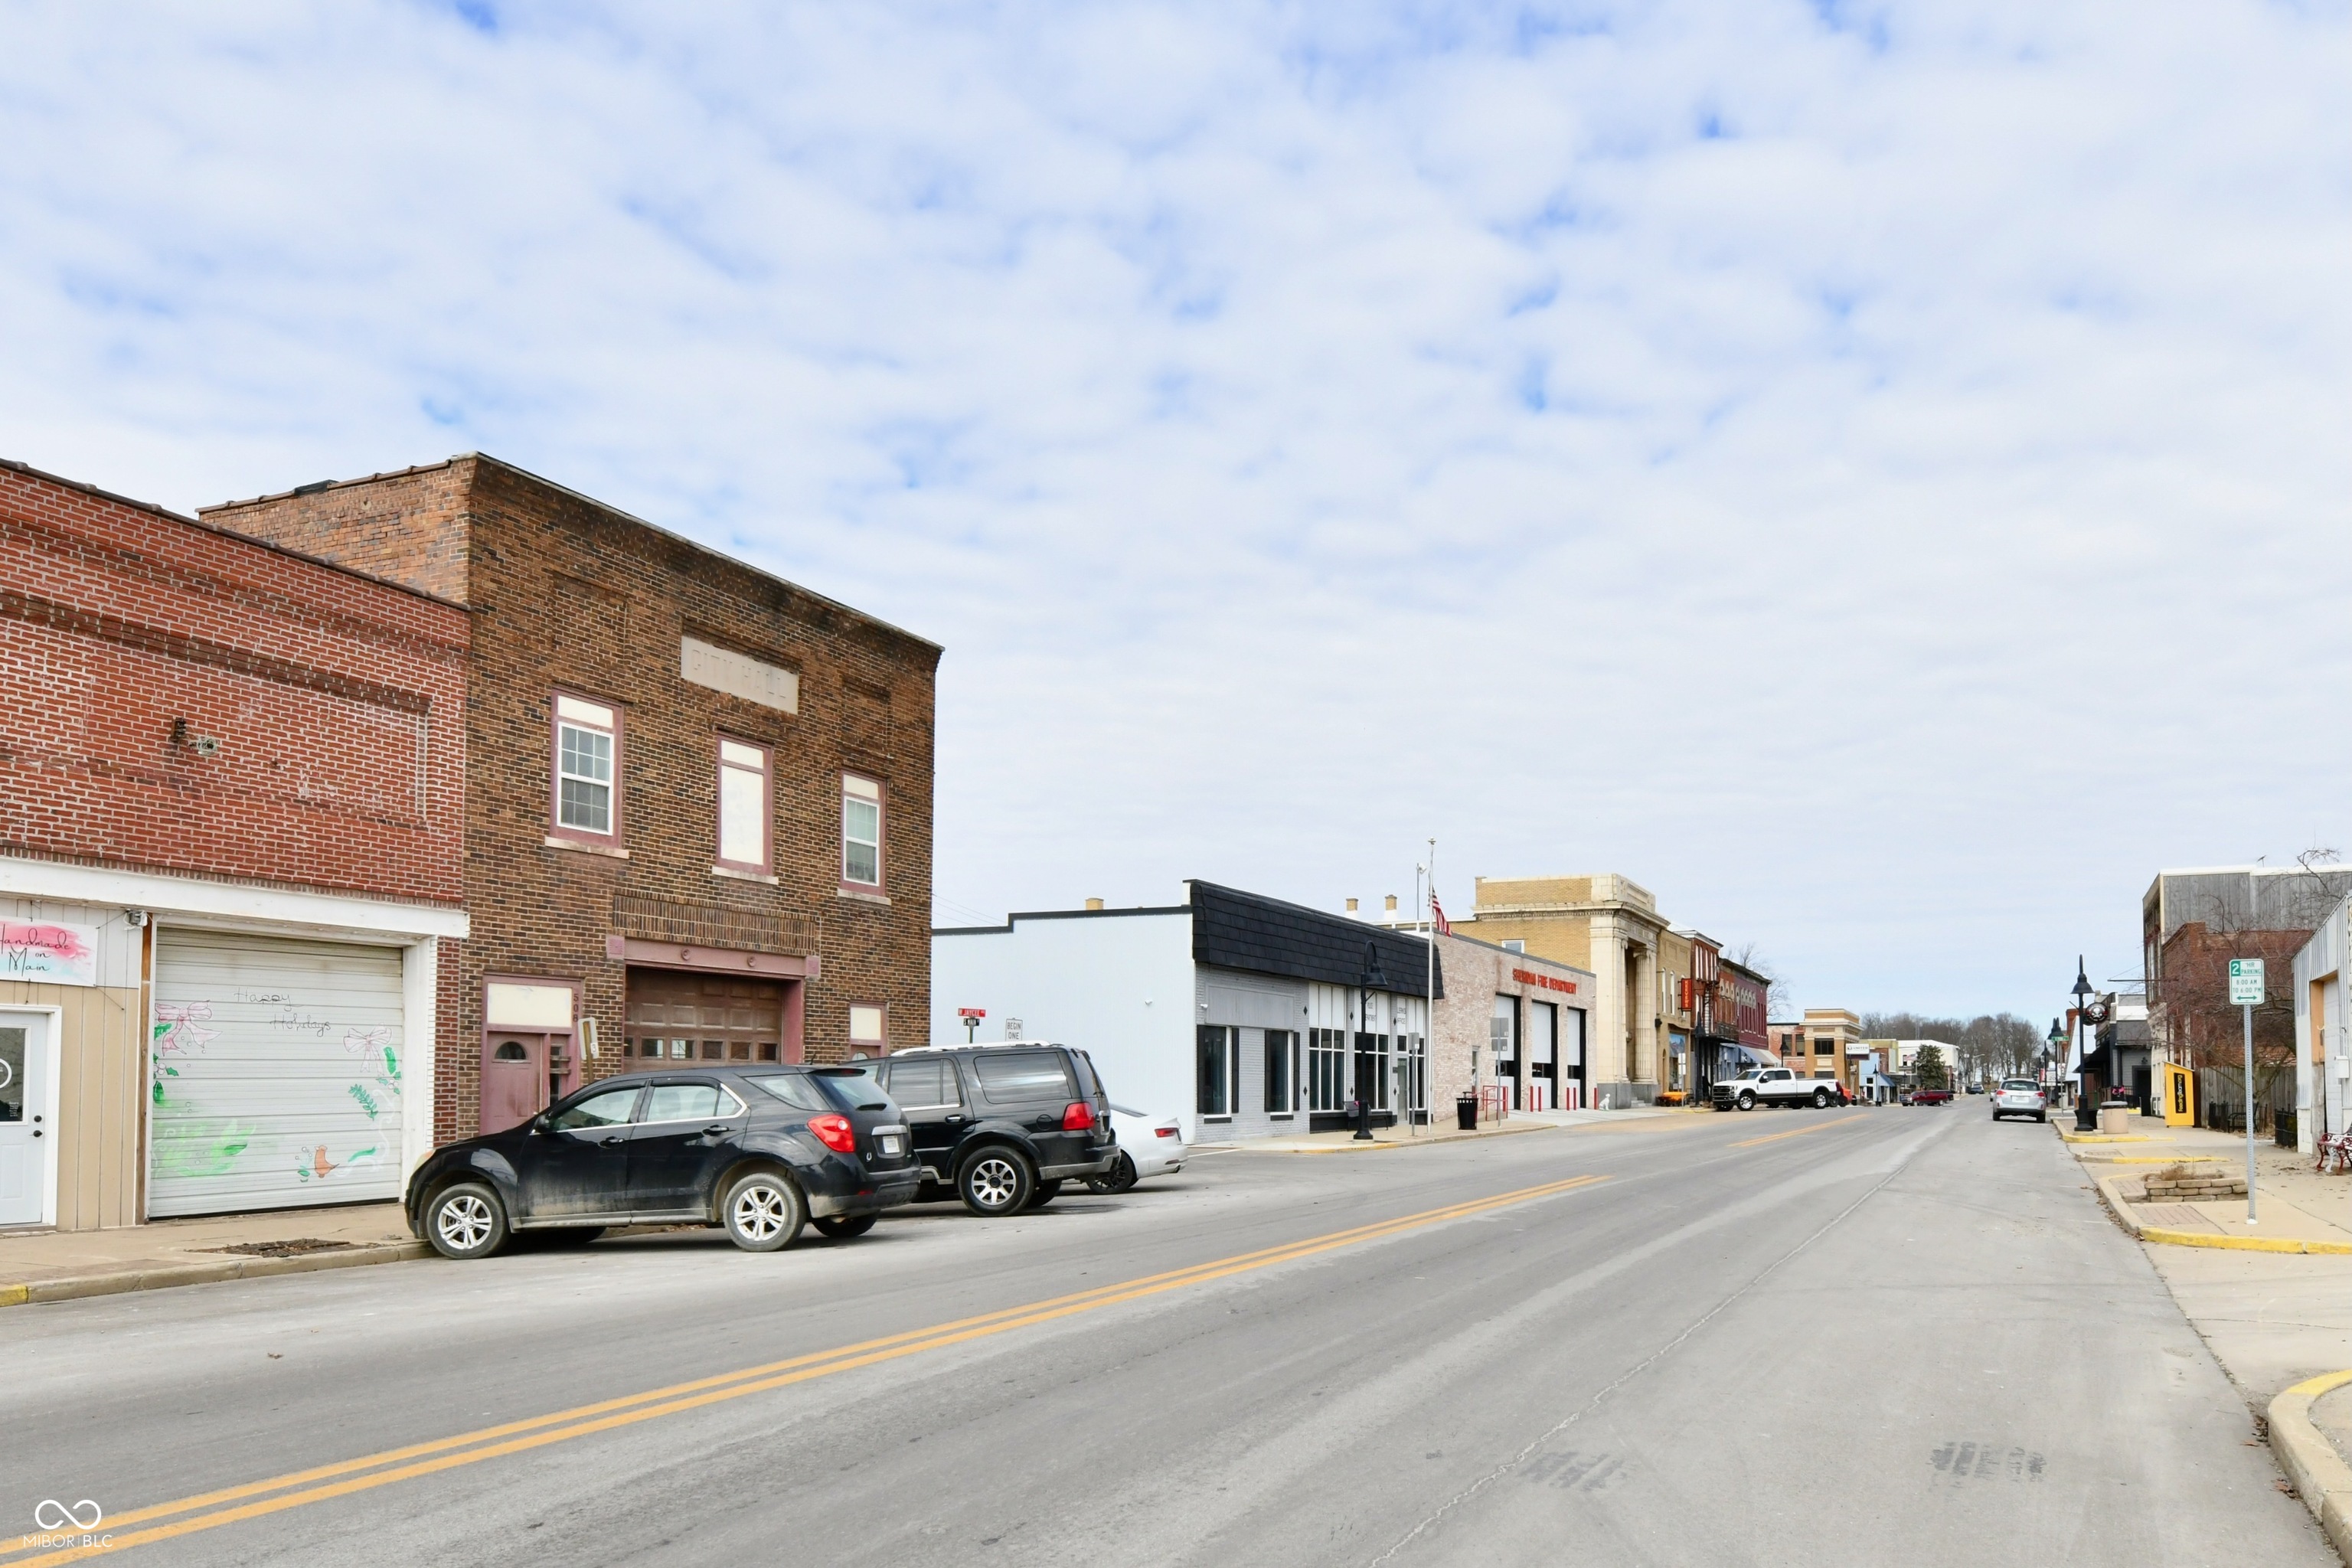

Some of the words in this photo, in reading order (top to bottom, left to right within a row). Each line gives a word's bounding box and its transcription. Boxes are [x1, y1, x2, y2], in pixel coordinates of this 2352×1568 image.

[691, 649, 733, 681] CITY
[742, 665, 786, 698] HALL
[8, 945, 51, 977] Main
[2232, 963, 2239, 975] 2
[1537, 975, 1548, 988] FIRE
[1549, 977, 1576, 995] DEPARTMENT
[234, 987, 292, 1011] Happy
[270, 1013, 332, 1037] Holidays
[1008, 1031, 1020, 1040] ONE
